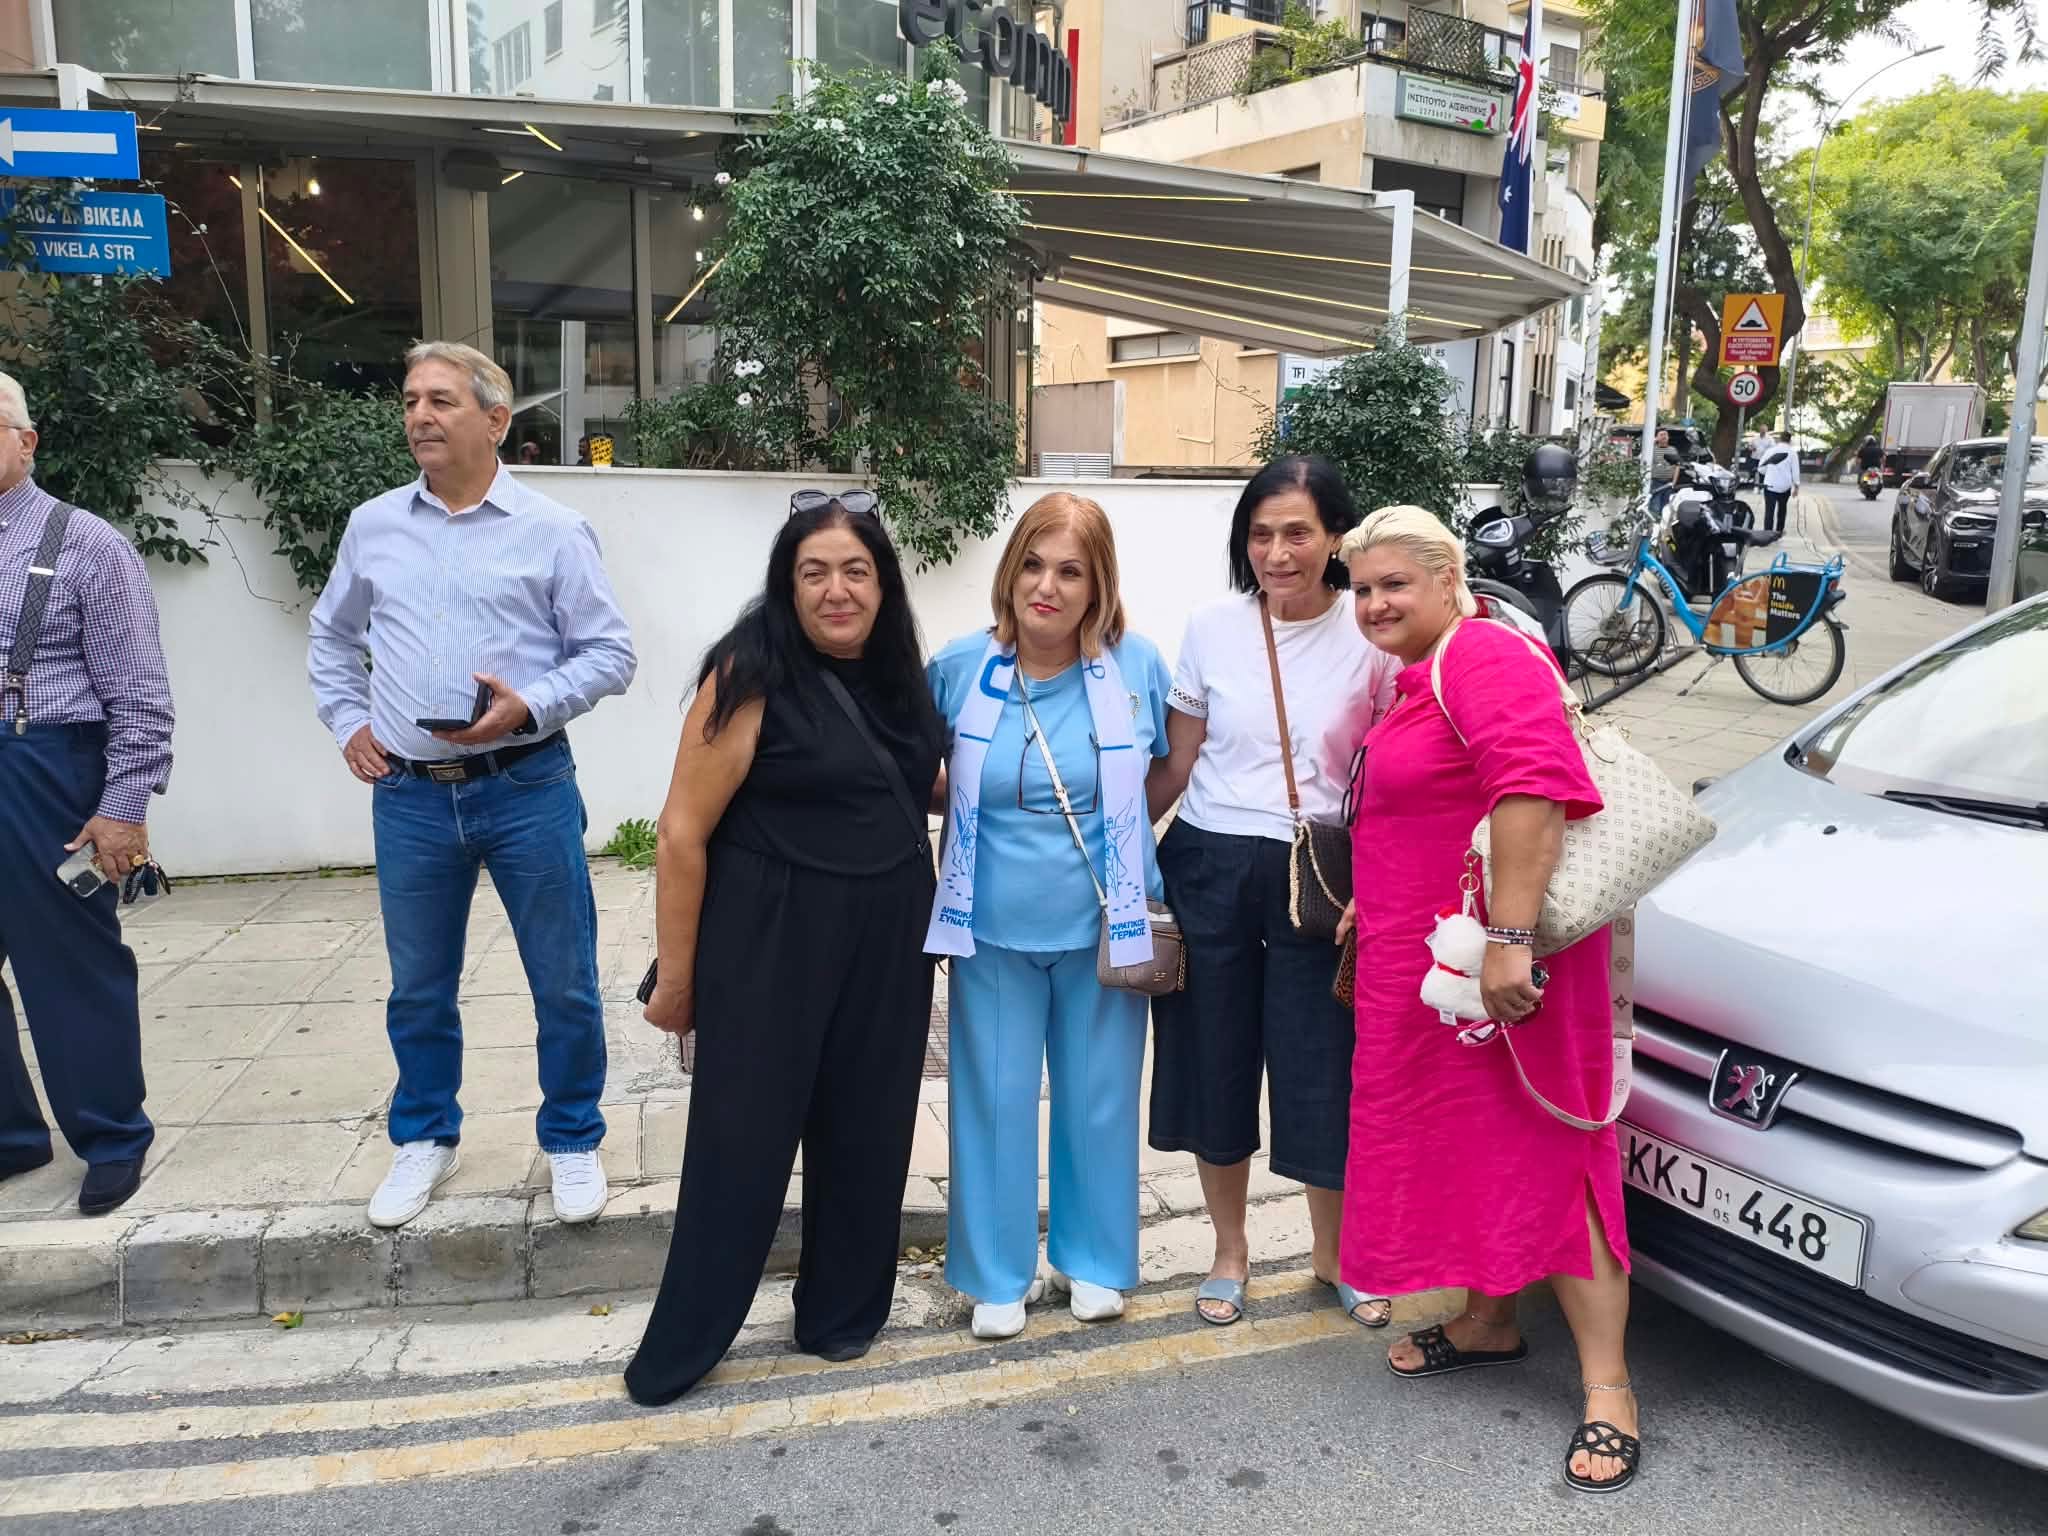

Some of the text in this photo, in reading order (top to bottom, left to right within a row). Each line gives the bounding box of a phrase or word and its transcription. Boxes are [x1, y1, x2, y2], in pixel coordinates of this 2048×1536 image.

[83, 206, 144, 228] ΒΙΚΕΛΑ
[43, 241, 100, 259] VIKELA
[103, 243, 135, 261] STR
[1733, 379, 1756, 396] 50
[1771, 592, 1787, 601] The
[1770, 600, 1794, 610] Inside
[1770, 608, 1800, 620] Matters
[1628, 1135, 1827, 1261] KKJ 448
[1714, 1188, 1731, 1203] 01
[1713, 1207, 1730, 1223] 05
